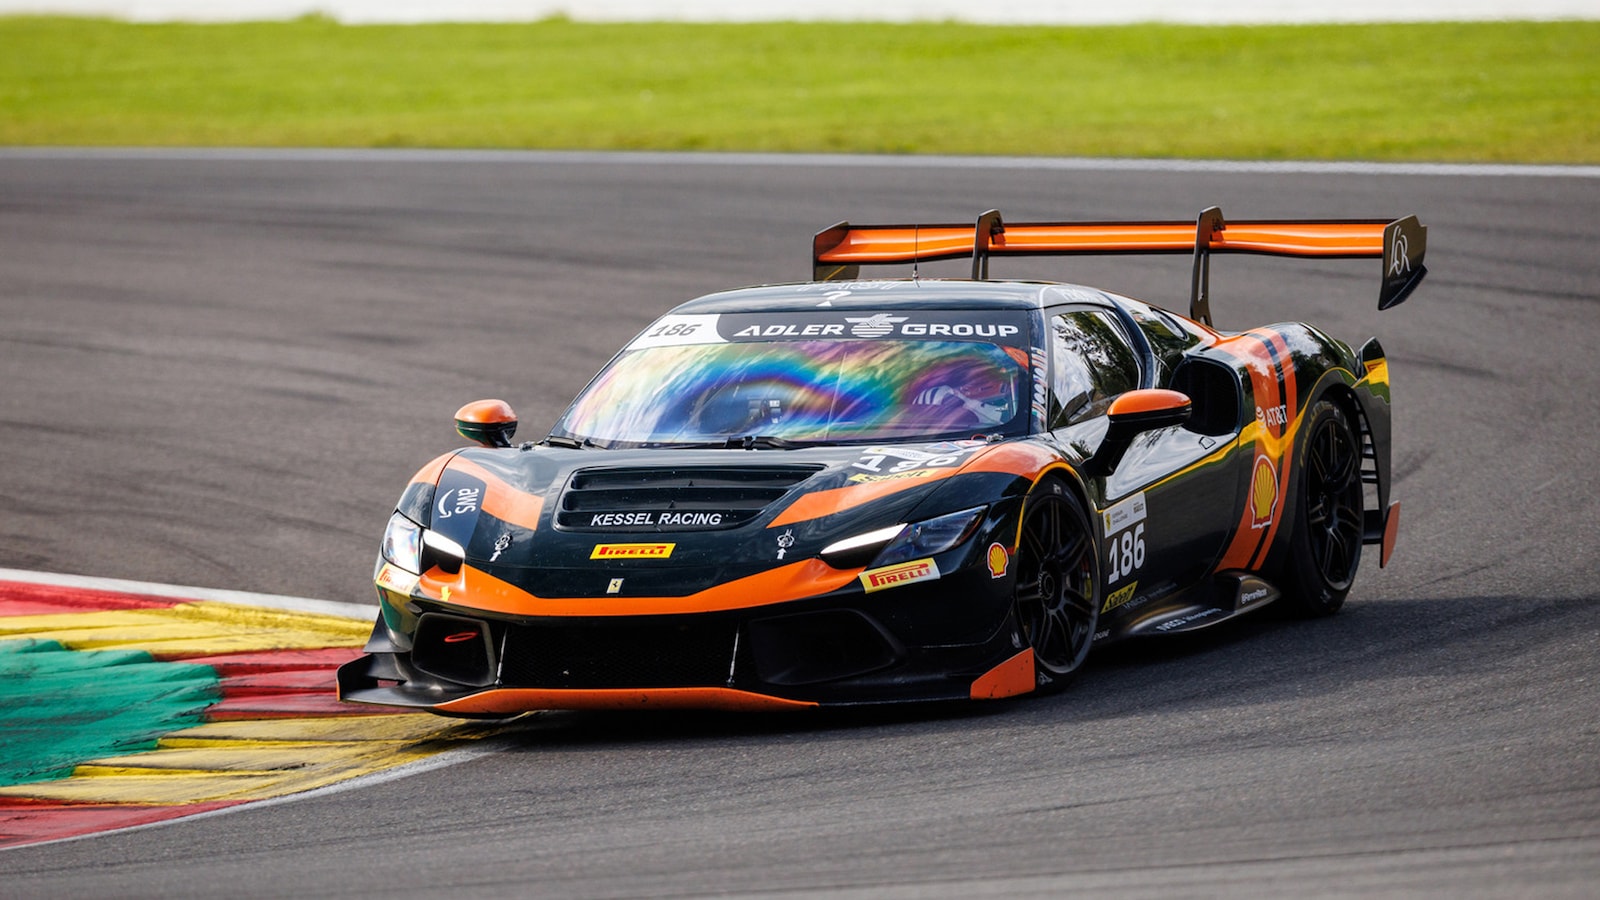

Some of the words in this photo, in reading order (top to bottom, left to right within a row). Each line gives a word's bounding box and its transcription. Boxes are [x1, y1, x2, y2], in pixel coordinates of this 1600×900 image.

[648, 323, 702, 338] 186
[733, 324, 844, 337] ADLER
[901, 324, 1018, 337] GROUP
[1265, 404, 1288, 427] AT&T
[455, 488, 480, 514] aws
[590, 513, 654, 527] KESSEL
[658, 513, 722, 526] RACING
[598, 545, 667, 556] PIRELLI
[1108, 522, 1146, 585] 186
[869, 562, 932, 588] PIRELLI
